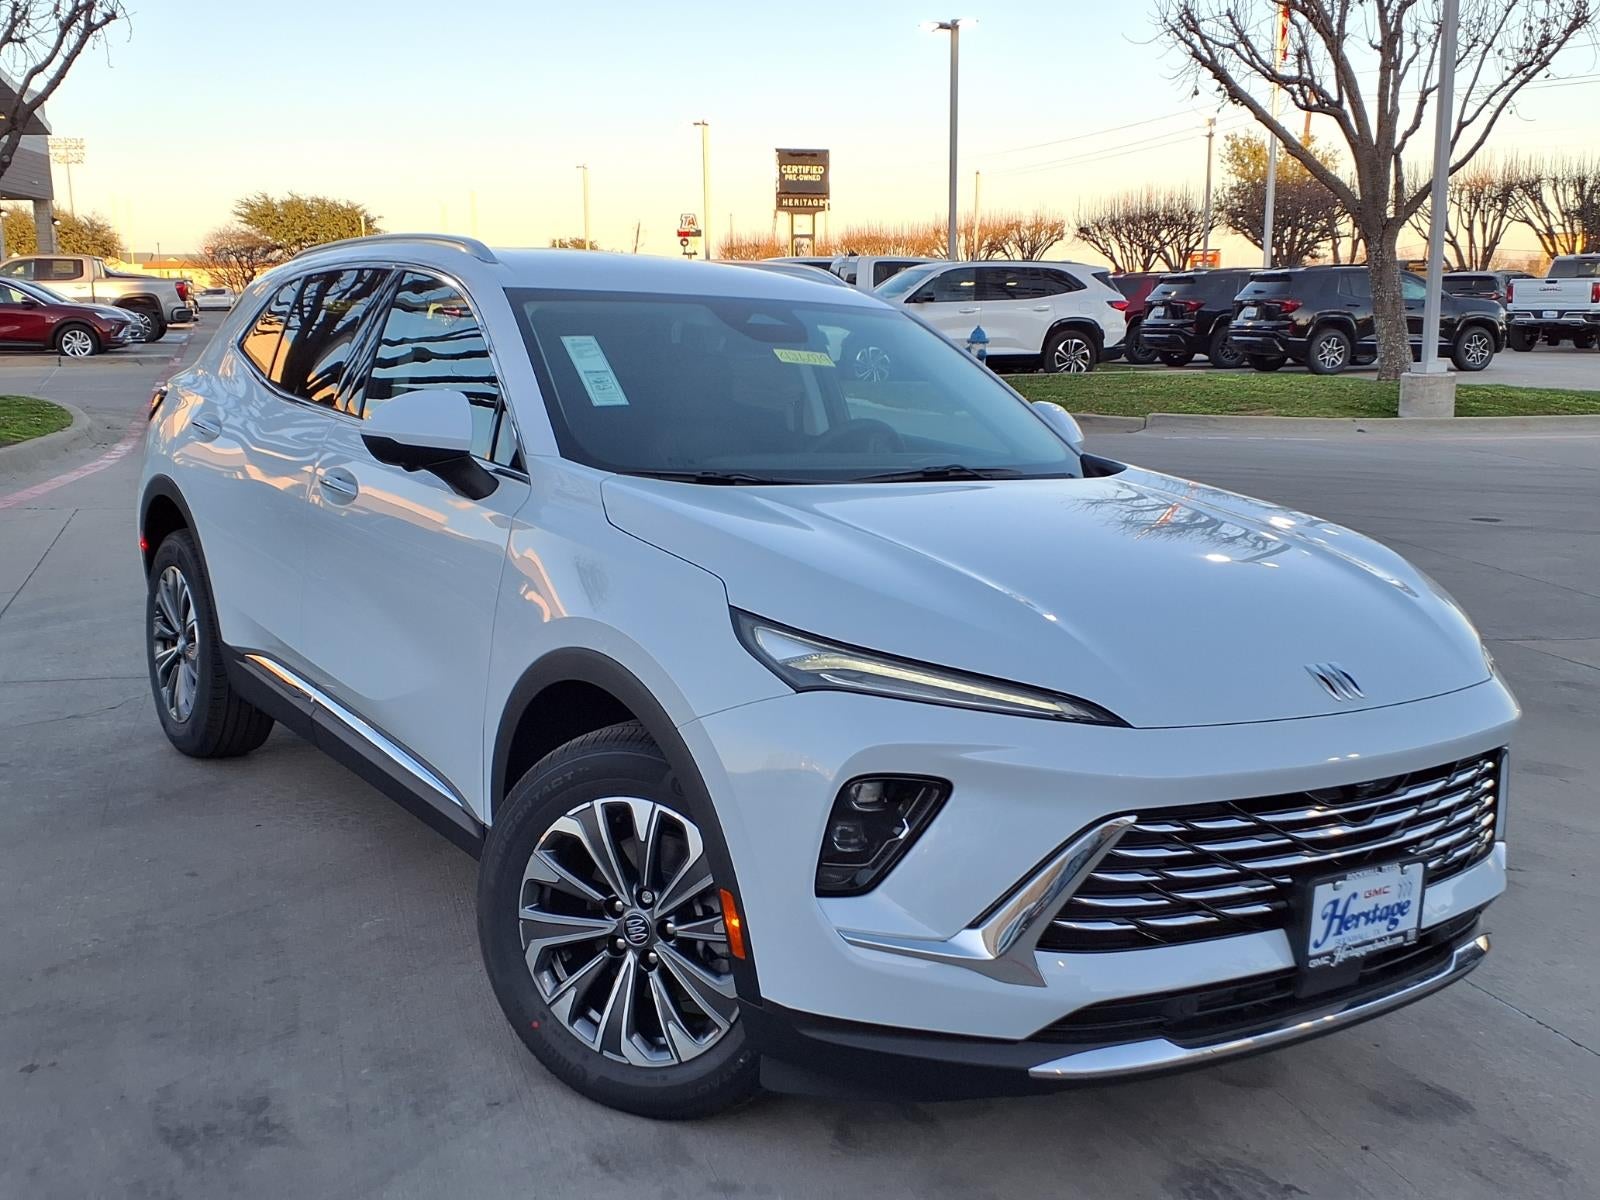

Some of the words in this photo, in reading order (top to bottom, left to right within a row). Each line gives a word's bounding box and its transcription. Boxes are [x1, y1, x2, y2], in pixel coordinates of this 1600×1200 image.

[781, 165, 825, 174] CERTIFIED
[782, 198, 825, 207] HERITAGE
[1363, 885, 1391, 899] GMC
[1312, 891, 1412, 949] Heritage
